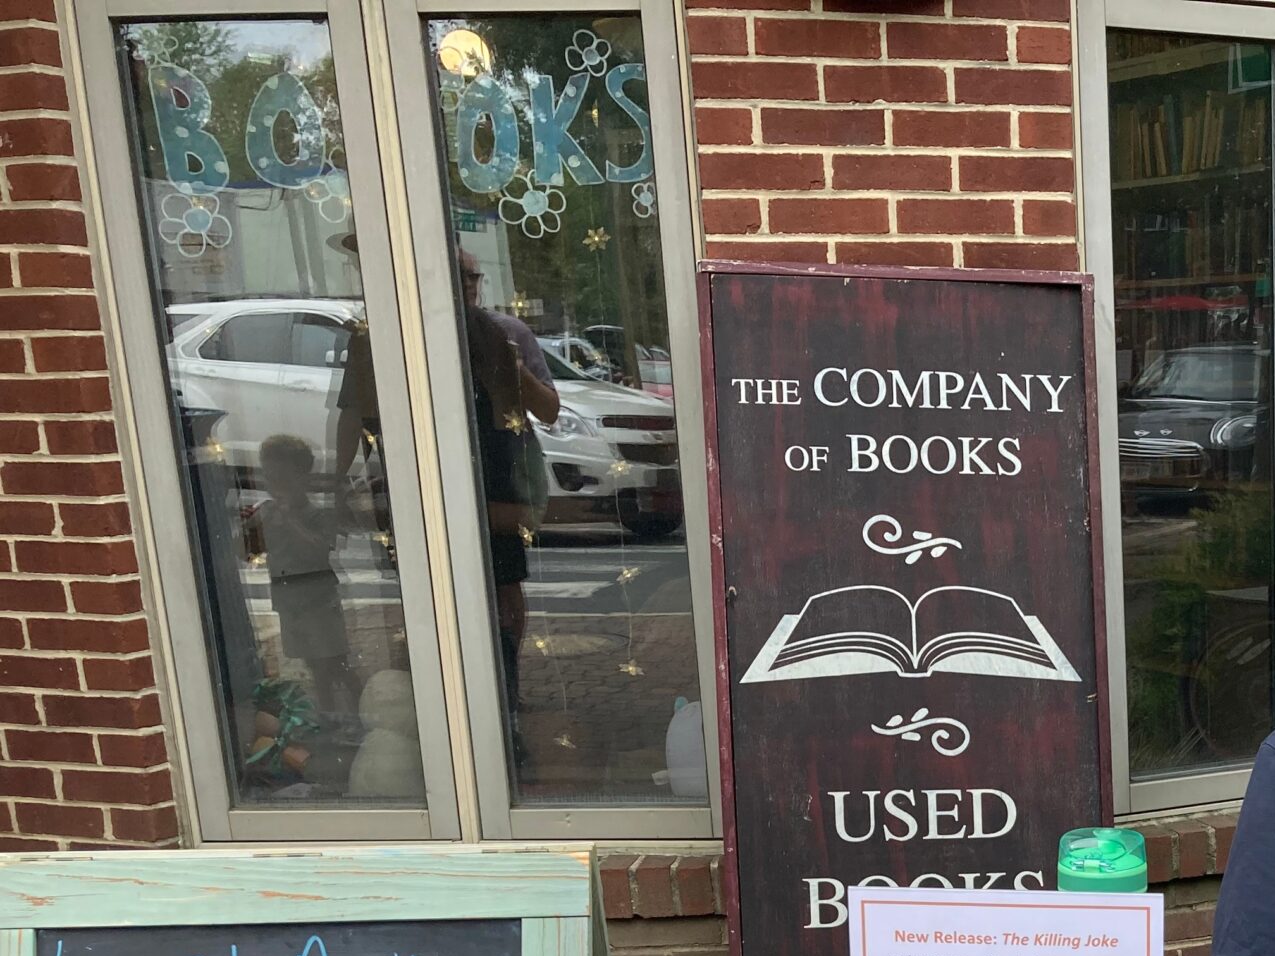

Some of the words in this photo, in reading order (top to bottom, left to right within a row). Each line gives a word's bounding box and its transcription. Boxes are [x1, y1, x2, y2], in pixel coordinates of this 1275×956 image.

[731, 378, 801, 405] THE
[813, 367, 1071, 414] COMPANY
[784, 444, 829, 472] OF
[846, 433, 1022, 477] BOOKS
[828, 788, 1017, 842] USED
[894, 930, 929, 943] New
[934, 931, 997, 945] Release:
[1002, 933, 1030, 946] The
[1034, 934, 1081, 950] Killing
[1084, 934, 1118, 948] Joke
